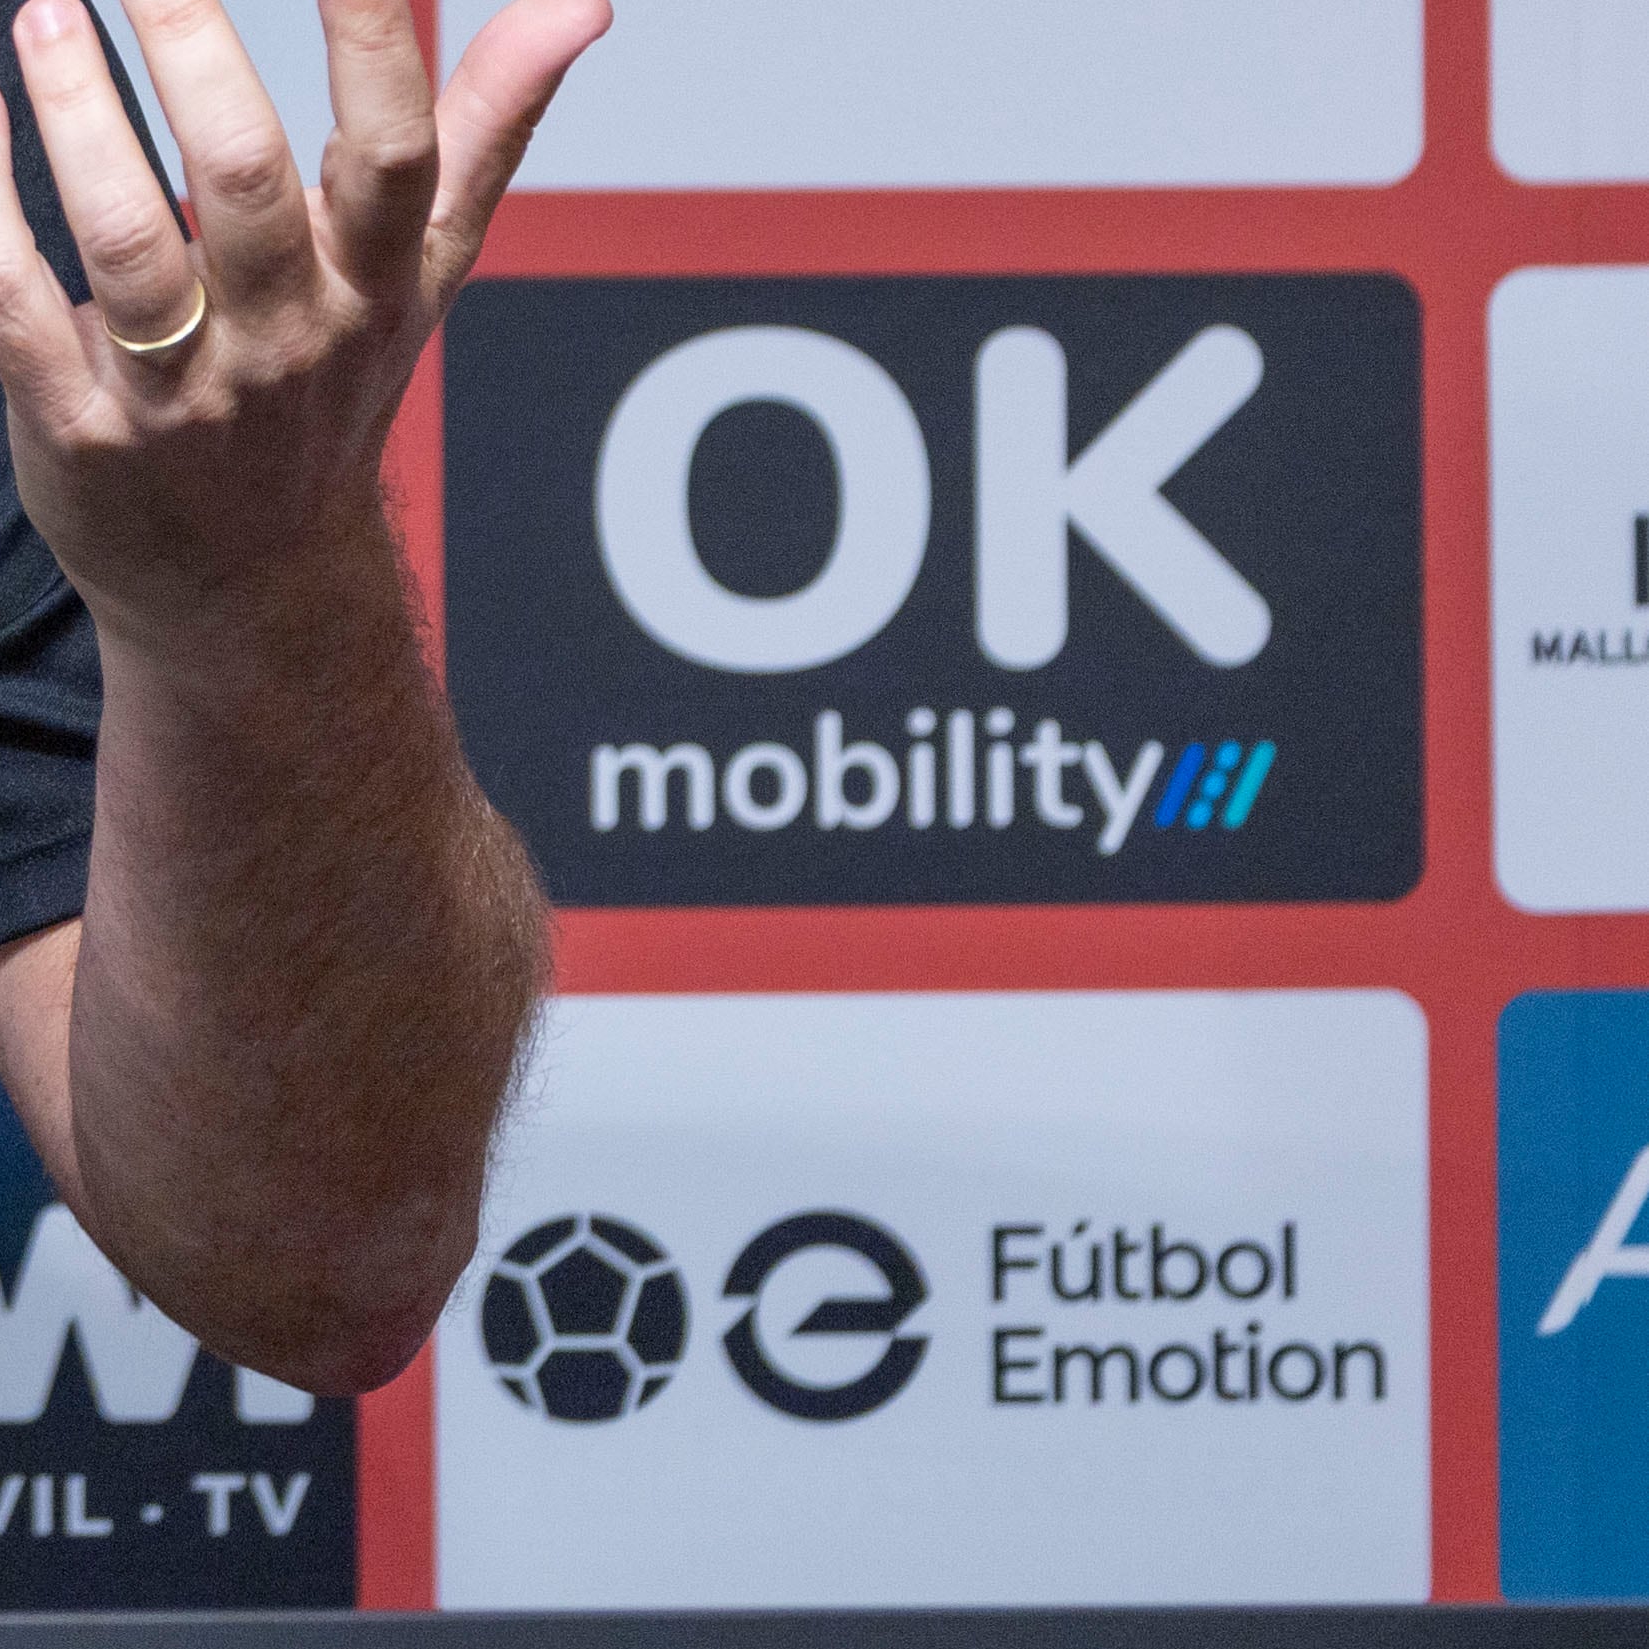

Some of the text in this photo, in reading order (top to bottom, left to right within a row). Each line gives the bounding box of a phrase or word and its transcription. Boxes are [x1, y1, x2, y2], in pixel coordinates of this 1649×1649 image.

[593, 323, 1273, 674] OK
[1531, 631, 1649, 665] MALL
[589, 707, 1164, 856] mobility
[990, 1220, 1298, 1305] Fútbol
[990, 1320, 1388, 1407] Emotion
[191, 1472, 312, 1538] TV
